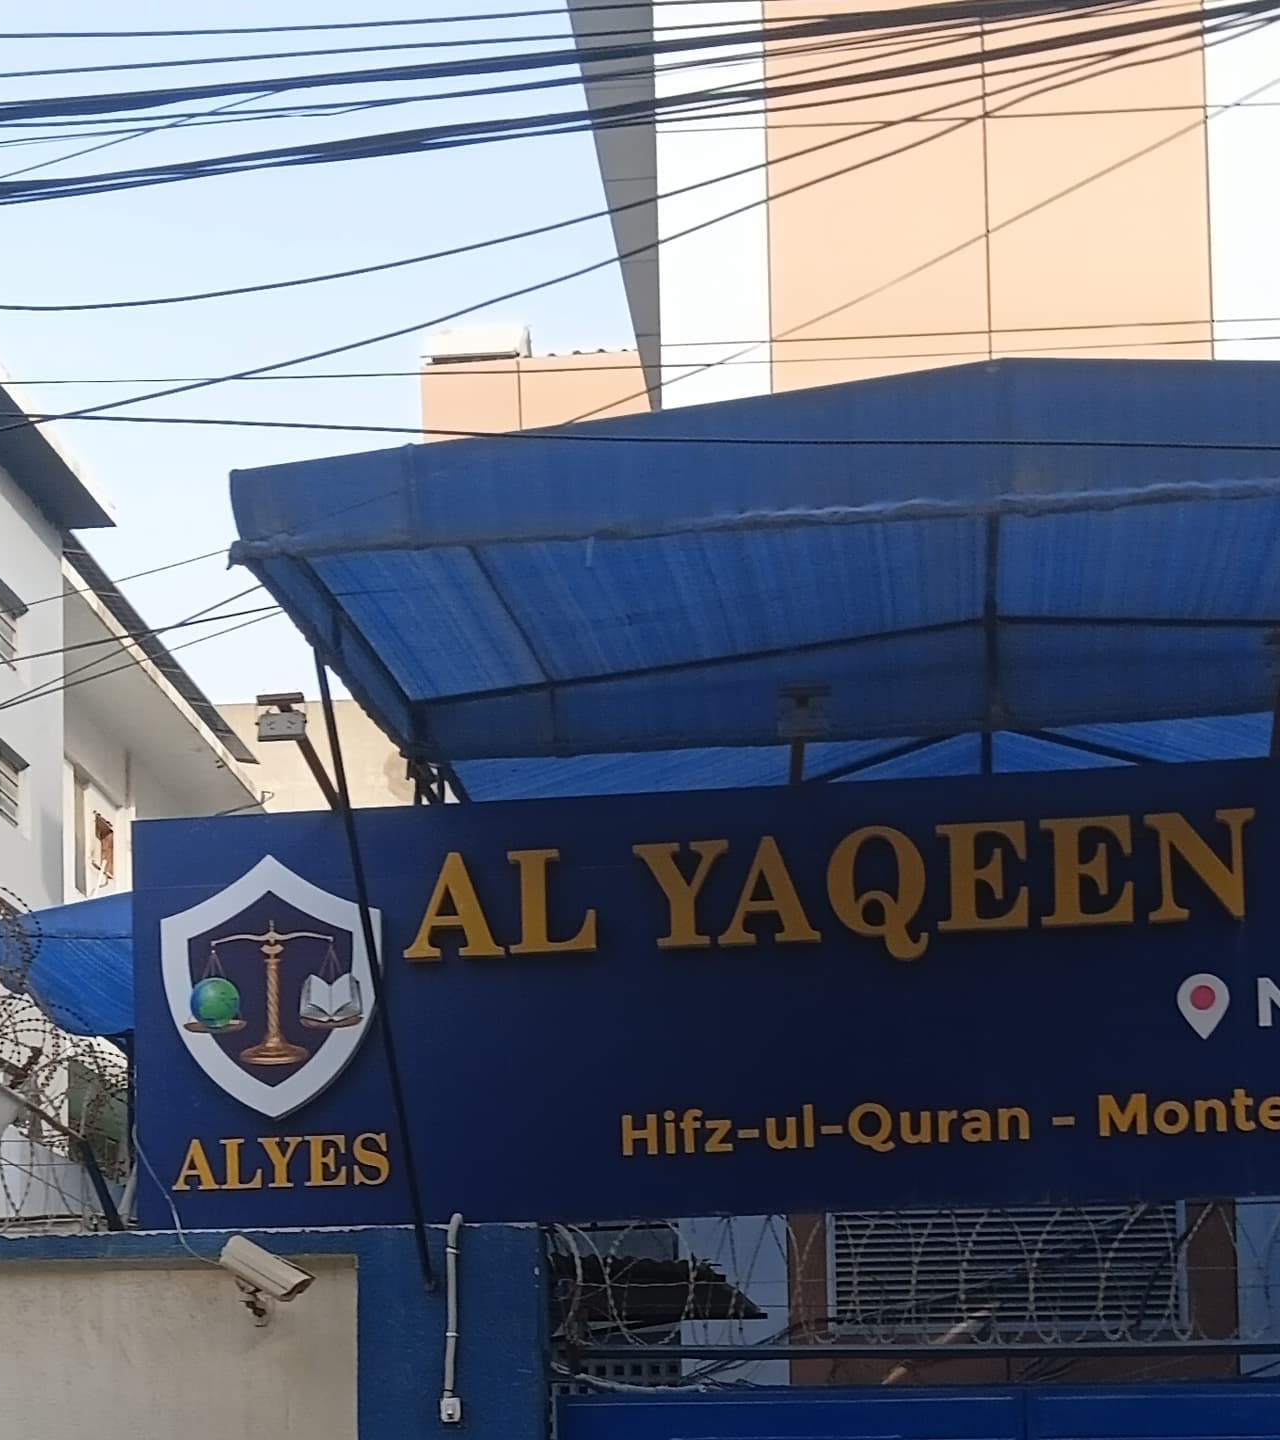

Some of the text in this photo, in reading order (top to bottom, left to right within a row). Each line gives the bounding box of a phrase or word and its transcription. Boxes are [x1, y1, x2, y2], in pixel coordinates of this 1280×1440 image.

[402, 848, 599, 961] AL
[632, 808, 1256, 962] YAQEEN
[620, 1102, 1032, 1157] Hifz-ul-Quran
[171, 1132, 392, 1192] ALYES
